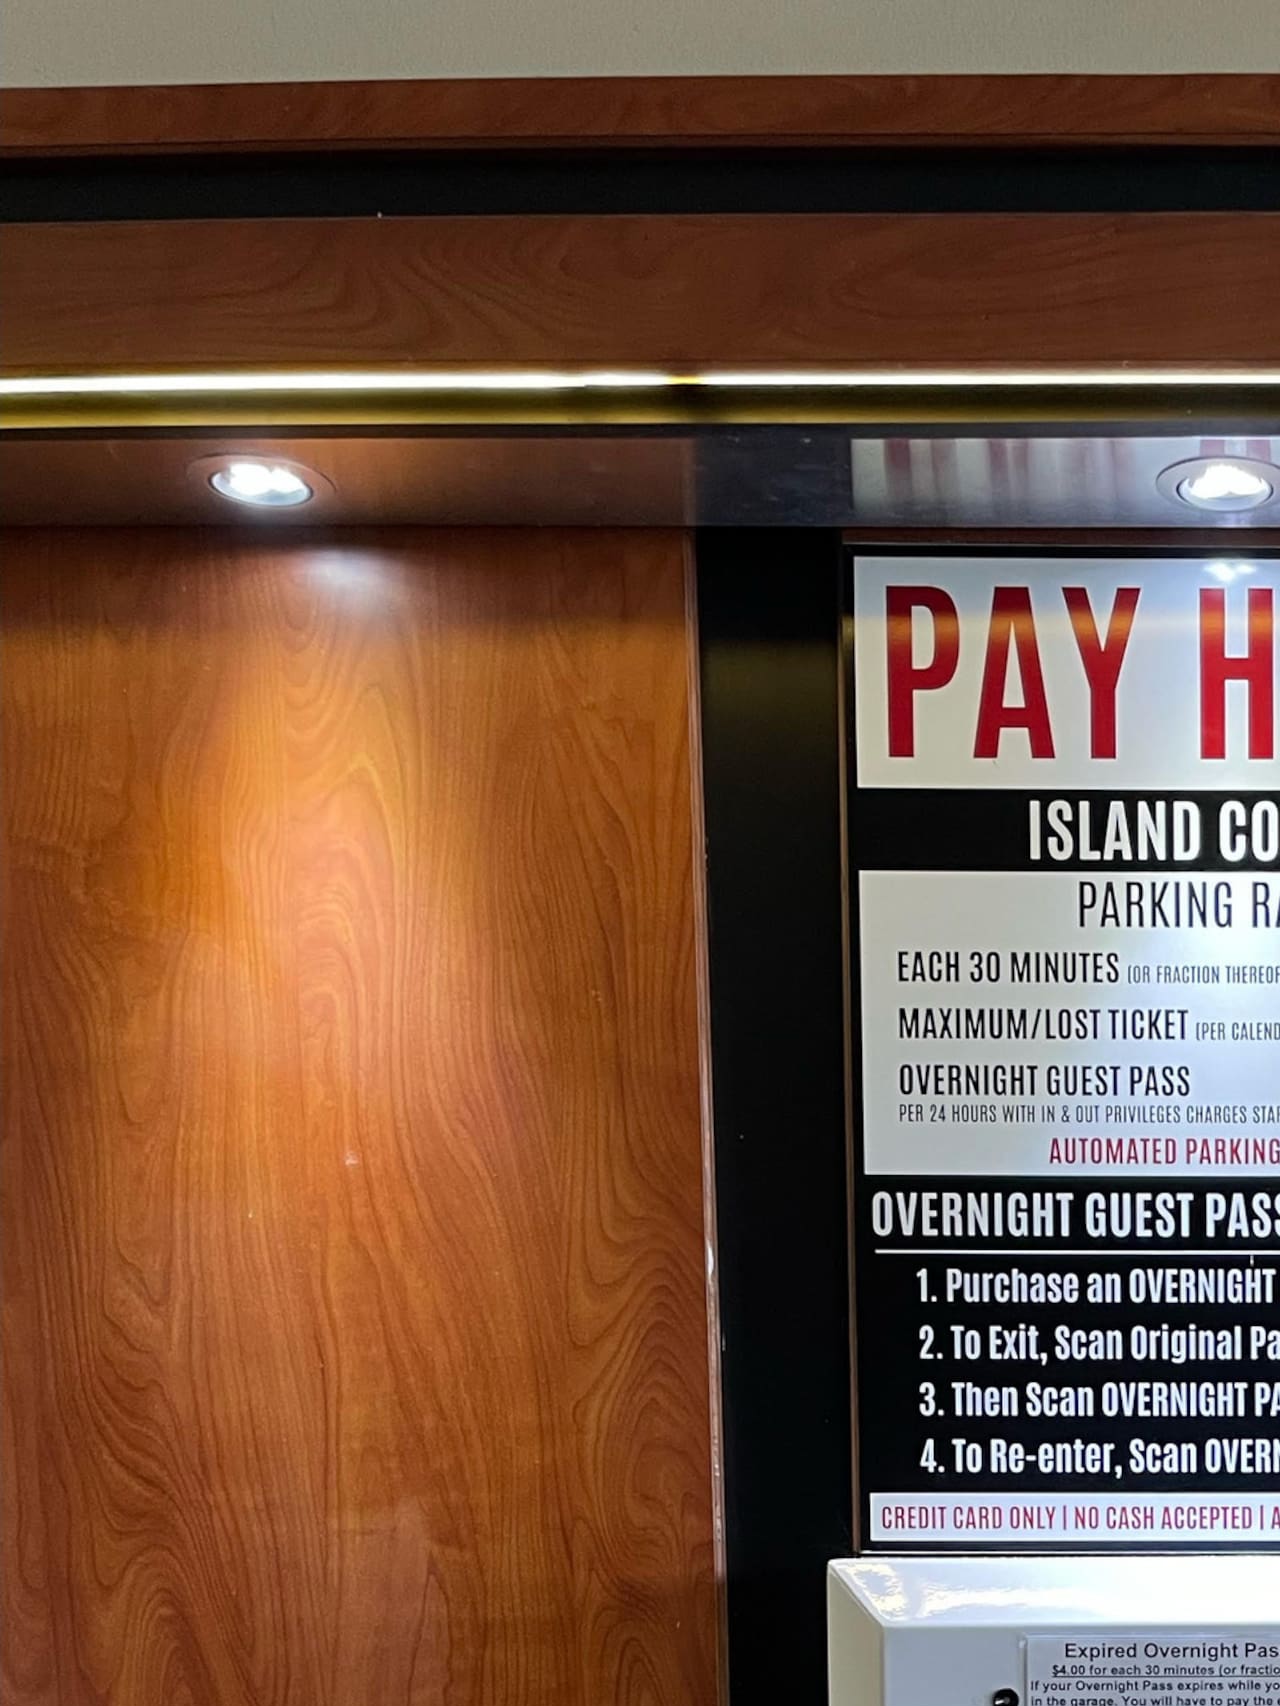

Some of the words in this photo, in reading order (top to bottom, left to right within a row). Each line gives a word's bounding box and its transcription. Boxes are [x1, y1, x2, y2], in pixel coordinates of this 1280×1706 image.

[887, 584, 1139, 759] PAY
[1029, 799, 1201, 861] ISLAND
[1079, 881, 1233, 928] PARKING
[897, 951, 960, 983] EACH
[969, 951, 1001, 983] 30
[1010, 951, 1119, 983] MINUTES
[1127, 964, 1151, 985] (OR
[1156, 965, 1220, 985] FRACTION
[899, 1007, 1101, 1040] MAXIMUM/LOST
[1107, 1009, 1189, 1041] TICKET
[1195, 1021, 1226, 1041] (PER
[899, 1063, 1039, 1097] OVERNIGHT
[1046, 1065, 1121, 1097] GUEST
[1129, 1065, 1190, 1097] PASS
[899, 1103, 924, 1123] PER
[929, 1103, 947, 1123] 24
[951, 1103, 997, 1123] HOURS
[1001, 1104, 1035, 1123] WITH
[1041, 1105, 1056, 1123] IN
[1061, 1104, 1071, 1123] &
[1075, 1104, 1100, 1124] OUT
[1105, 1105, 1181, 1124] PRIVILEGES
[1186, 1105, 1247, 1124] CHARGES
[1049, 1137, 1177, 1165] AUTOMATED
[1185, 1137, 1280, 1165] PARKING
[871, 1191, 1075, 1237] OVERNIGHT
[1085, 1192, 1195, 1238] GUEST
[916, 1267, 938, 1303] 1.
[946, 1267, 1079, 1304] Purchase
[1086, 1272, 1122, 1304] an
[1129, 1267, 1277, 1304] OVERNIGHT
[919, 1324, 944, 1360] 2.
[949, 1325, 981, 1360] To
[989, 1323, 1048, 1366] Exit,
[1054, 1324, 1123, 1361] Scan
[1130, 1323, 1243, 1365] Original
[919, 1381, 945, 1417] 3.
[951, 1381, 1019, 1417] Then
[1025, 1381, 1095, 1417] Scan
[1101, 1381, 1249, 1417] OVERNIGHT
[919, 1437, 945, 1473] 4.
[951, 1438, 983, 1474] To
[990, 1438, 1123, 1480] Re-enter,
[1129, 1437, 1197, 1474] Scan
[881, 1505, 947, 1530] CREDIT
[953, 1505, 1003, 1530] CARD
[1009, 1505, 1056, 1530] ONLY
[1074, 1505, 1099, 1530] NO
[1105, 1505, 1155, 1530] CASH
[1161, 1505, 1253, 1530] ACCEPTED
[1065, 1642, 1137, 1662] Expired
[1143, 1642, 1239, 1662] Overnight
[1052, 1664, 1085, 1678] $4.00
[1089, 1664, 1108, 1678] for
[1111, 1664, 1141, 1678] each
[1145, 1664, 1159, 1678] 30
[1163, 1664, 1214, 1678] minutes
[1220, 1664, 1237, 1678] (or
